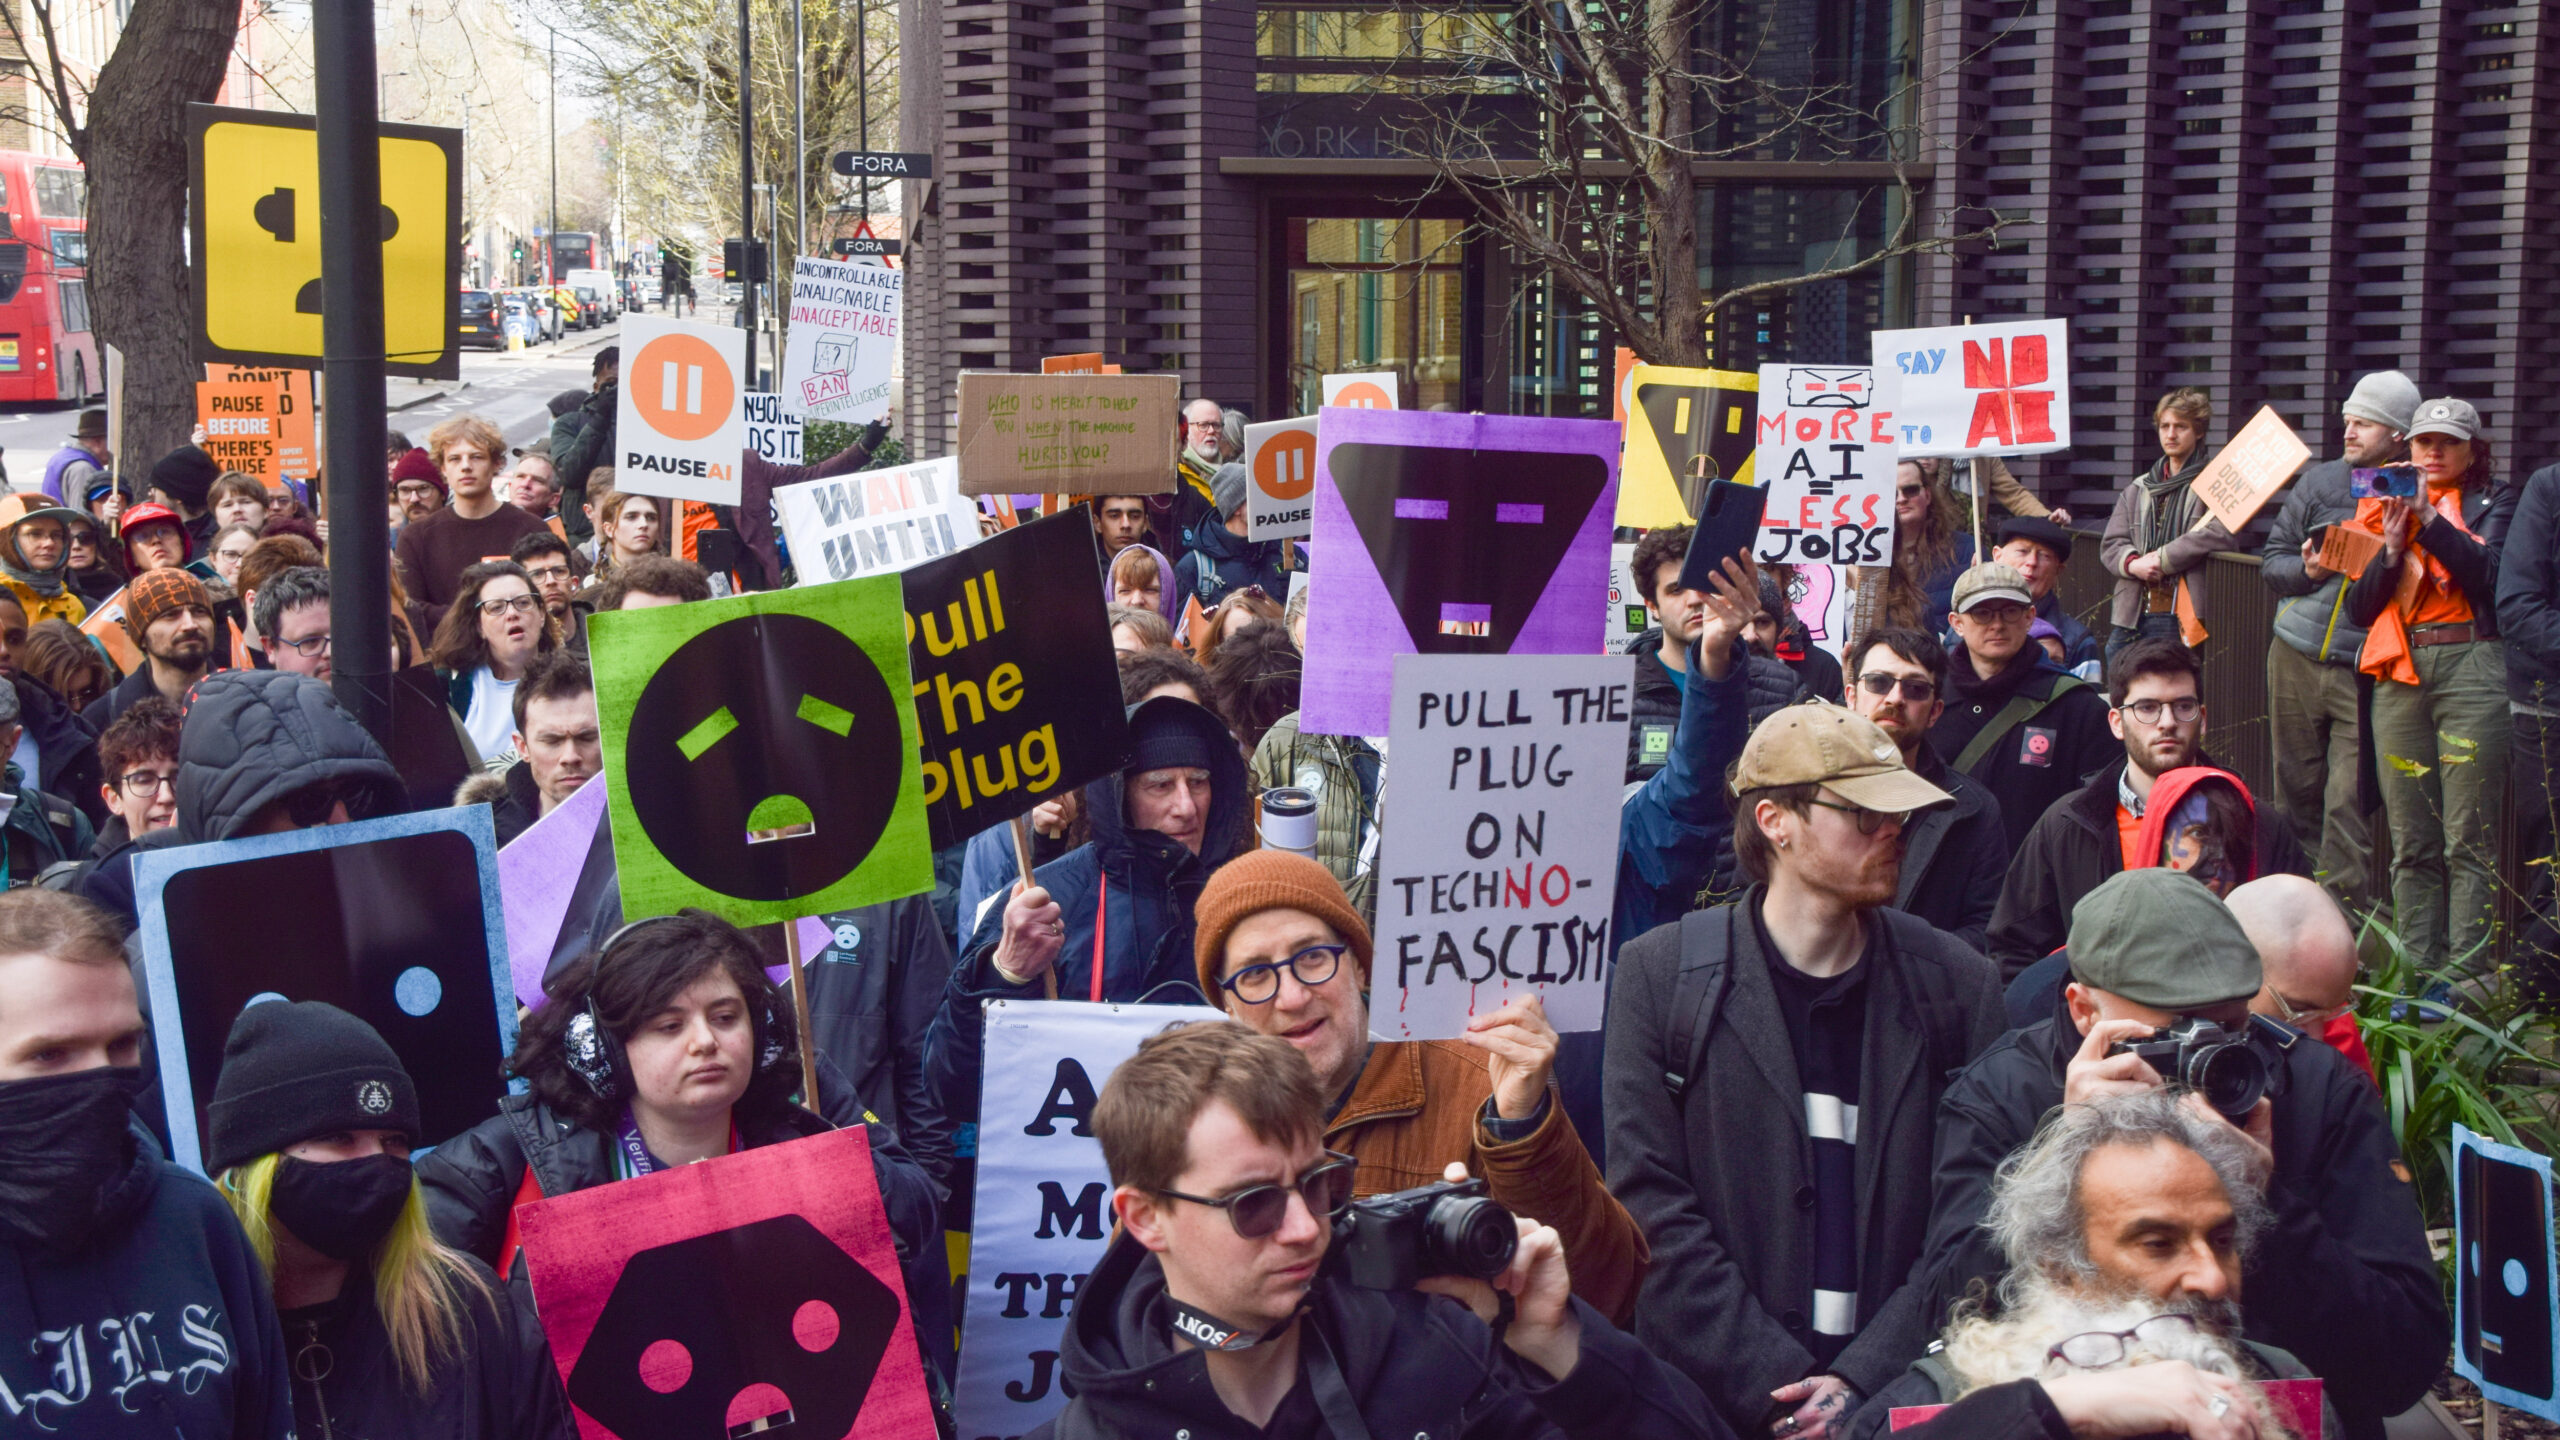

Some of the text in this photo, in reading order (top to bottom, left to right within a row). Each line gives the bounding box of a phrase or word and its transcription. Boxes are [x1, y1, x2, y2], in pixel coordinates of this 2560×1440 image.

[1261, 126, 1499, 157] YORK HOUSE
[852, 156, 907, 172] FORA
[845, 241, 884, 252] FORA
[795, 262, 901, 290] UNCONTROLLABLE
[793, 282, 893, 313] UNALIGNABLE
[791, 305, 898, 337] UNACCEPTABLE
[1896, 334, 2049, 389] SAY NO
[212, 396, 264, 412] PAUSE
[806, 376, 845, 400] BAN
[988, 394, 1020, 411] WHO
[1032, 394, 1043, 411] IS
[1051, 395, 1094, 411] MEANT
[207, 418, 270, 435] BEFORE
[993, 419, 1136, 434] YOU WHEN THE MACHINE
[1757, 407, 1894, 445] MORE
[1901, 389, 2056, 448] TO AI
[206, 440, 273, 457] THERE'S
[1018, 444, 1110, 464] HURTS YOU?
[1783, 444, 1864, 480] AI
[2218, 463, 2255, 502] DON'T
[2231, 447, 2269, 489] STEER
[811, 466, 940, 528] WAIT
[1760, 494, 1881, 529] LESS
[2208, 479, 2239, 514] RACE
[1256, 508, 1311, 527] PAUSE
[1760, 523, 1889, 565] JOBS
[904, 568, 1006, 657] ull
[1419, 684, 1629, 730] PULL THE
[1449, 742, 1573, 791] PLUG
[1466, 810, 1545, 859] ON
[1392, 861, 1592, 916] TECHNO-
[1396, 915, 1608, 988] FASCISM
[1034, 1181, 1114, 1239] M
[1174, 1311, 1229, 1345] SONY
